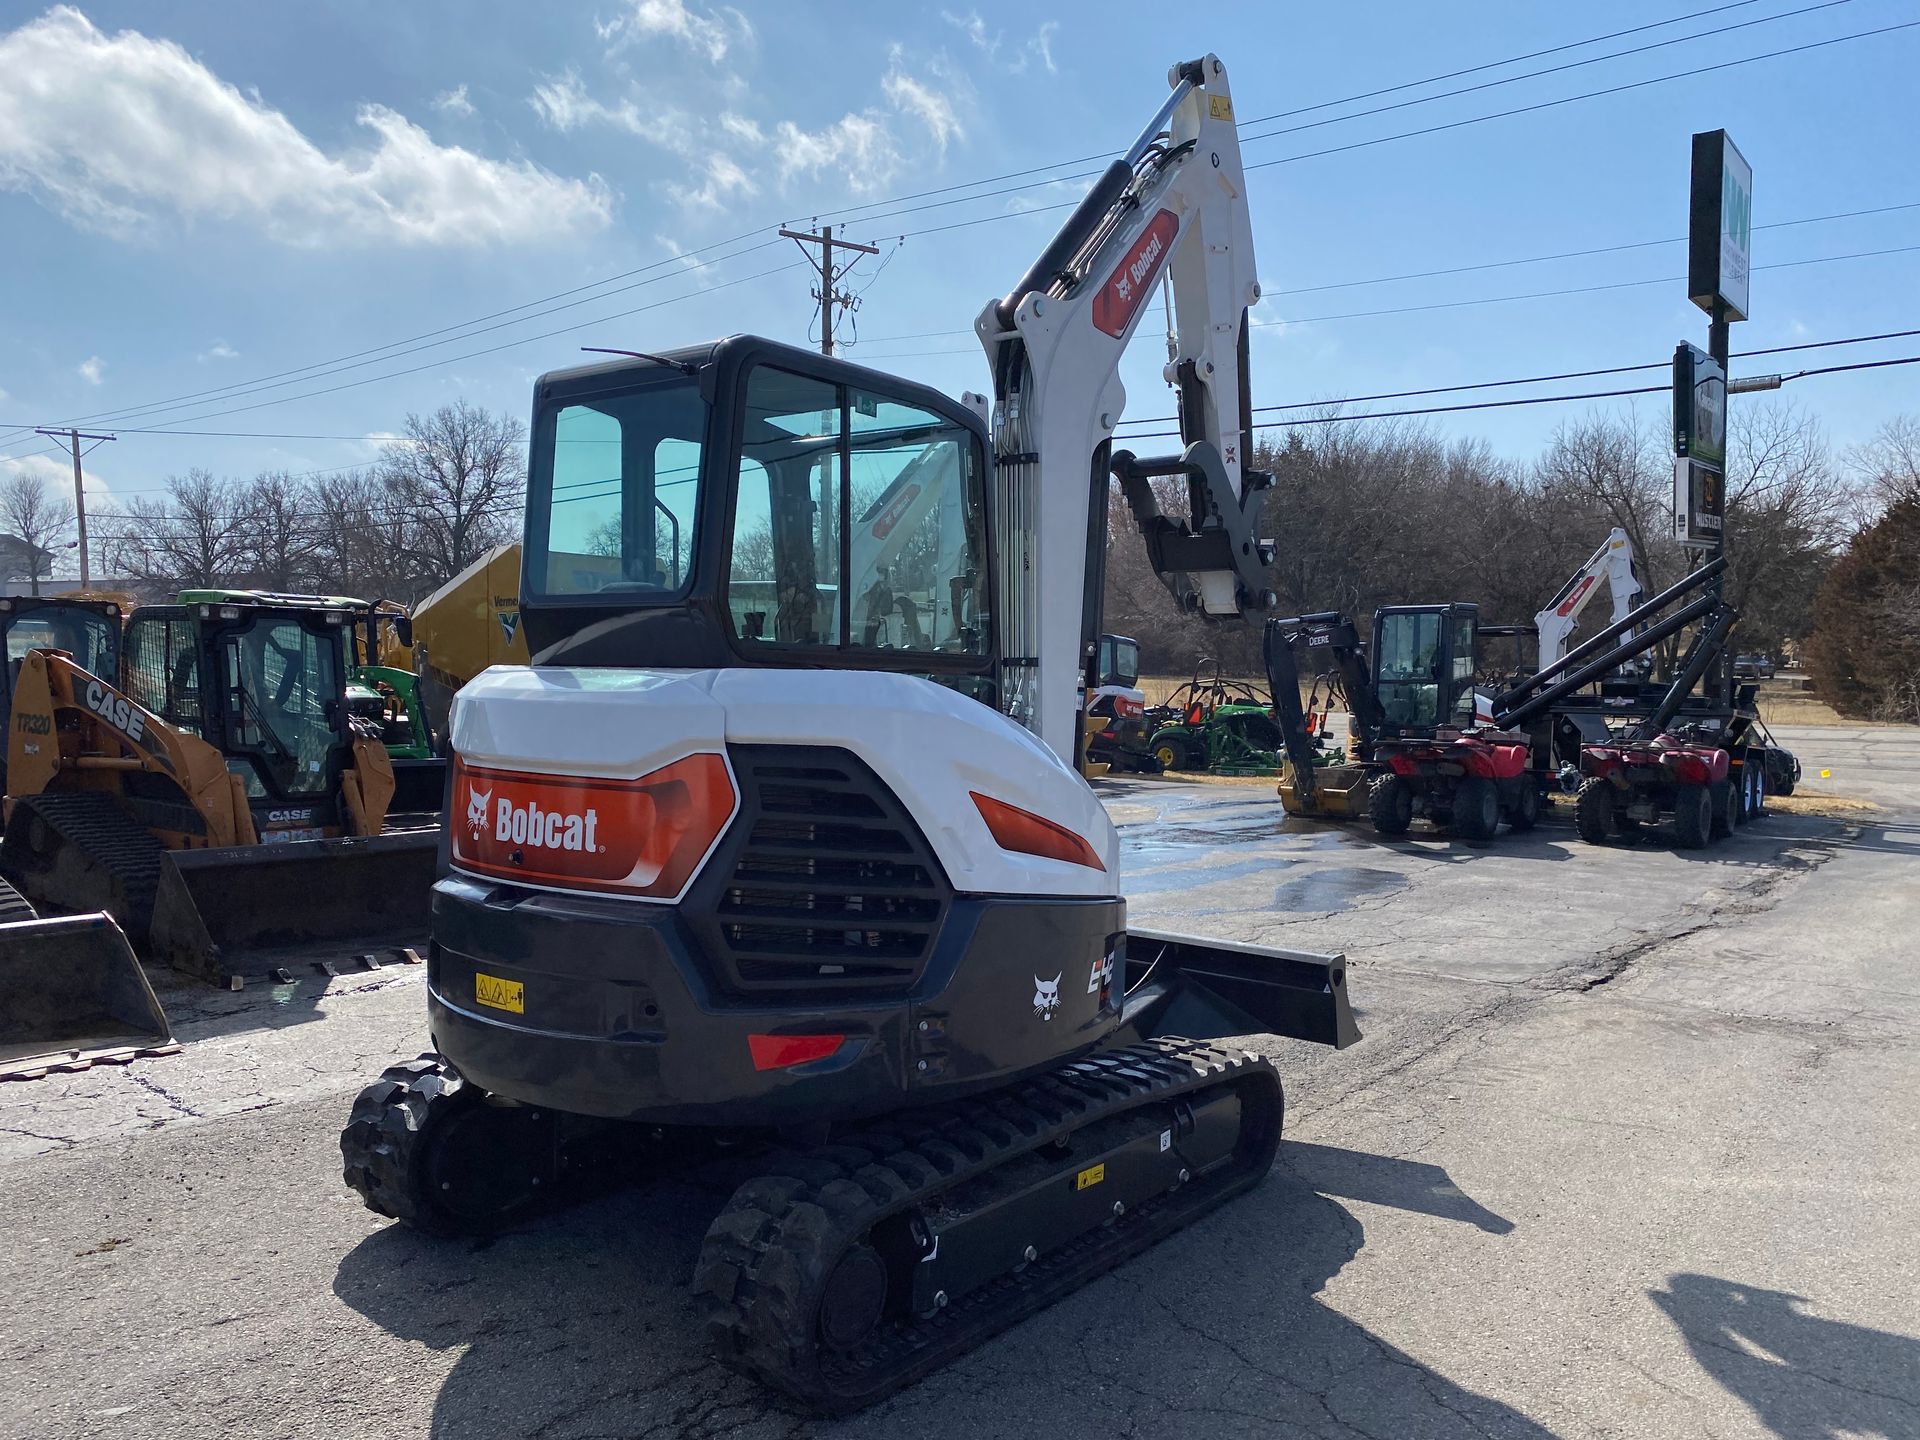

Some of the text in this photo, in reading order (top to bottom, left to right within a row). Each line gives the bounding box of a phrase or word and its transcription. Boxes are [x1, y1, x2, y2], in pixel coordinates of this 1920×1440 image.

[1130, 232, 1162, 285] Bobcat
[1696, 511, 1722, 530] HUSTLER
[1309, 635, 1330, 647] DEERE
[86, 680, 146, 742] CASE
[16, 712, 51, 735] TR320
[268, 808, 312, 822] CASE
[495, 797, 598, 853] Bobcat
